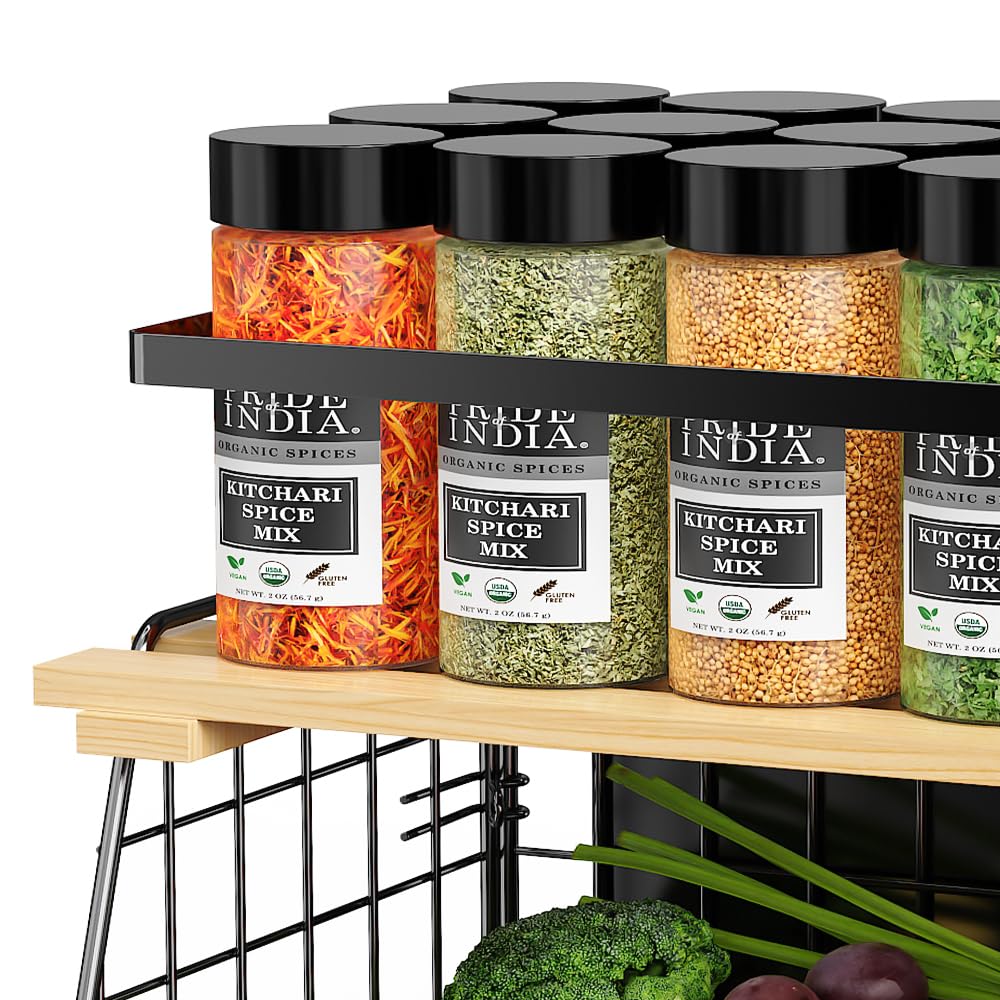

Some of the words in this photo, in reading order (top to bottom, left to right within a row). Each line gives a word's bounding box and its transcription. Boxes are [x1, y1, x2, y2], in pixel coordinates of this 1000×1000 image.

[218, 440, 278, 457] ORGANIC
[286, 448, 357, 458] SPICES
[443, 455, 505, 472] ORGANIC
[513, 464, 585, 473] SPICES
[675, 470, 740, 487] ORGANIC
[748, 479, 821, 489] SPICES
[226, 479, 342, 502] KITCHARI
[909, 485, 977, 503] ORGANIC
[242, 504, 314, 523] SPICE
[451, 495, 571, 518] KITCHARI
[467, 519, 542, 539] SPICE
[683, 511, 806, 534] KITCHARI
[254, 525, 301, 543] MIX
[479, 541, 528, 559] MIX
[701, 536, 778, 555] SPICE
[713, 557, 763, 576] MIX
[949, 574, 1000, 593] MIX
[251, 590, 266, 598] WT.
[454, 589, 472, 597] VEGAN
[460, 605, 475, 613] NET
[477, 607, 492, 615] WT.
[686, 607, 705, 615] VEGAN
[693, 622, 708, 630] NET
[920, 624, 940, 632] VEGAN
[928, 640, 943, 648] NET
[945, 643, 961, 651] WT.
